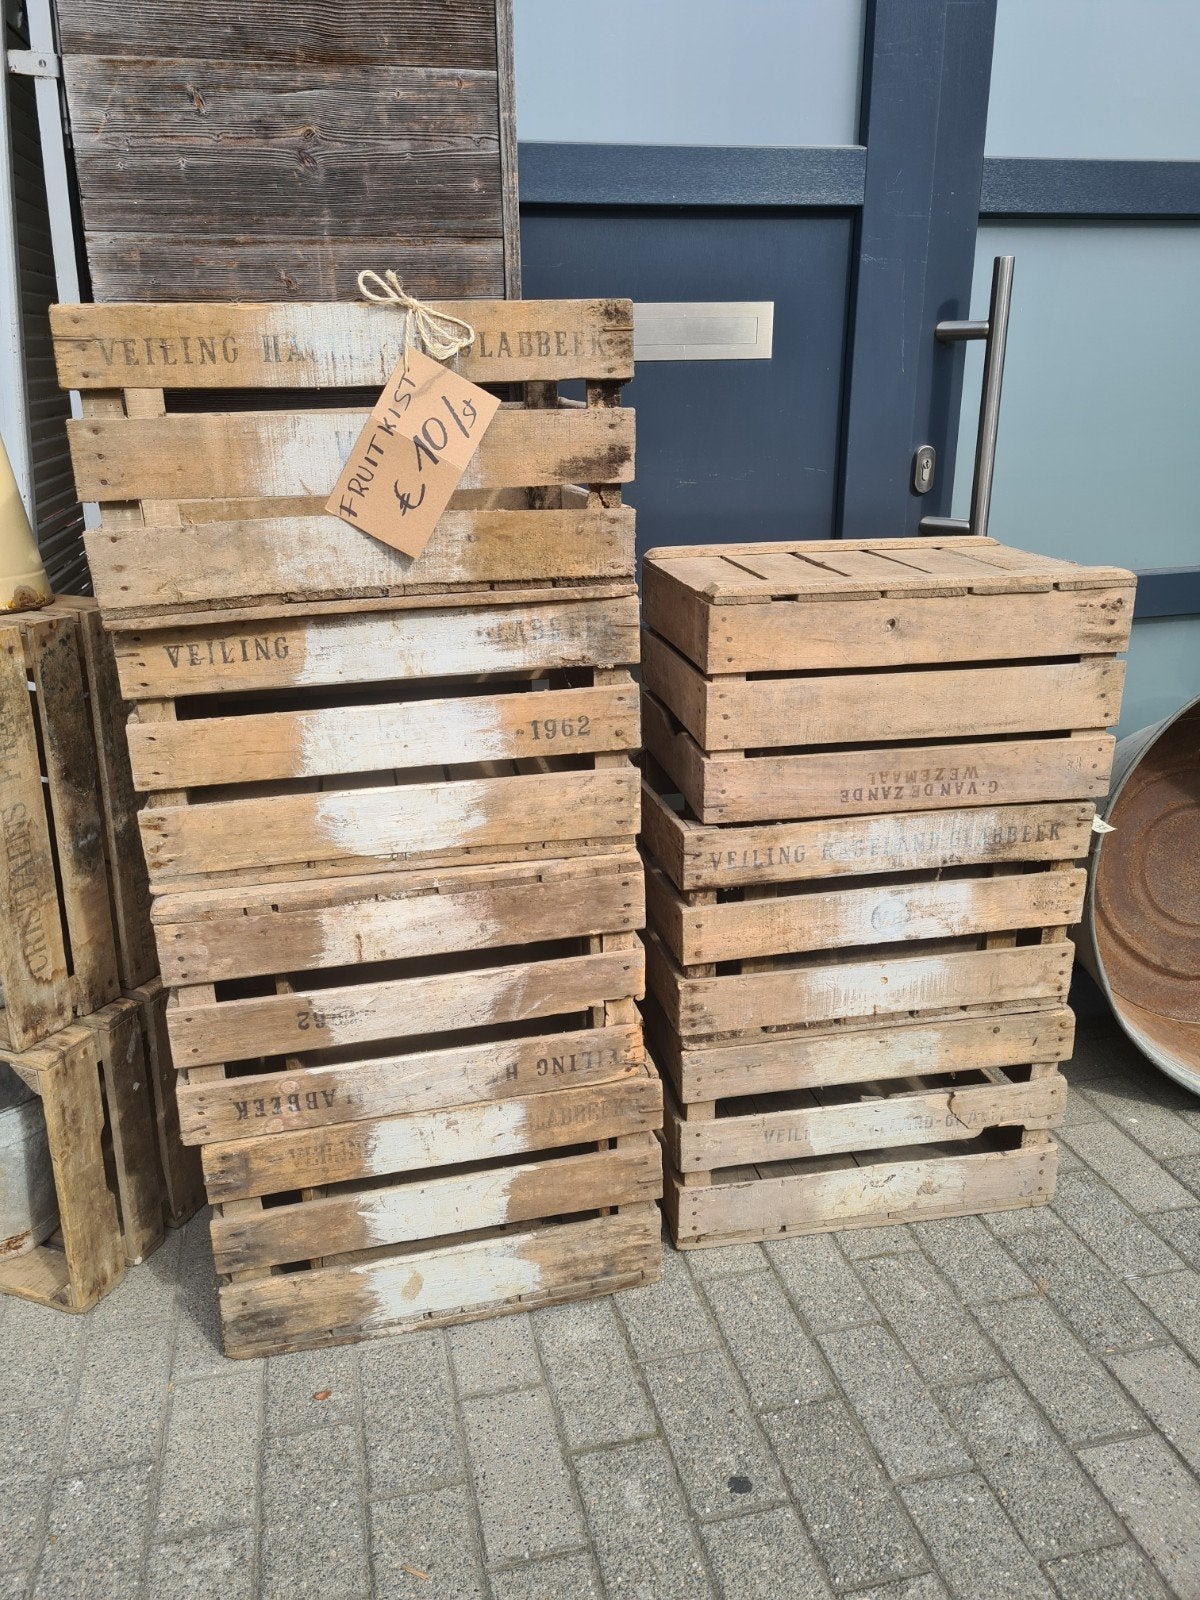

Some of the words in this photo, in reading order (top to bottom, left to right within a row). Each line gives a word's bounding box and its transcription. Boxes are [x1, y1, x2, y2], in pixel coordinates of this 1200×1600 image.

[97, 335, 239, 367] VEILING
[163, 635, 290, 669] VEILING
[530, 714, 592, 741] 1962
[866, 766, 979, 785] WEZEMAAL
[708, 844, 807, 871] VEILING
